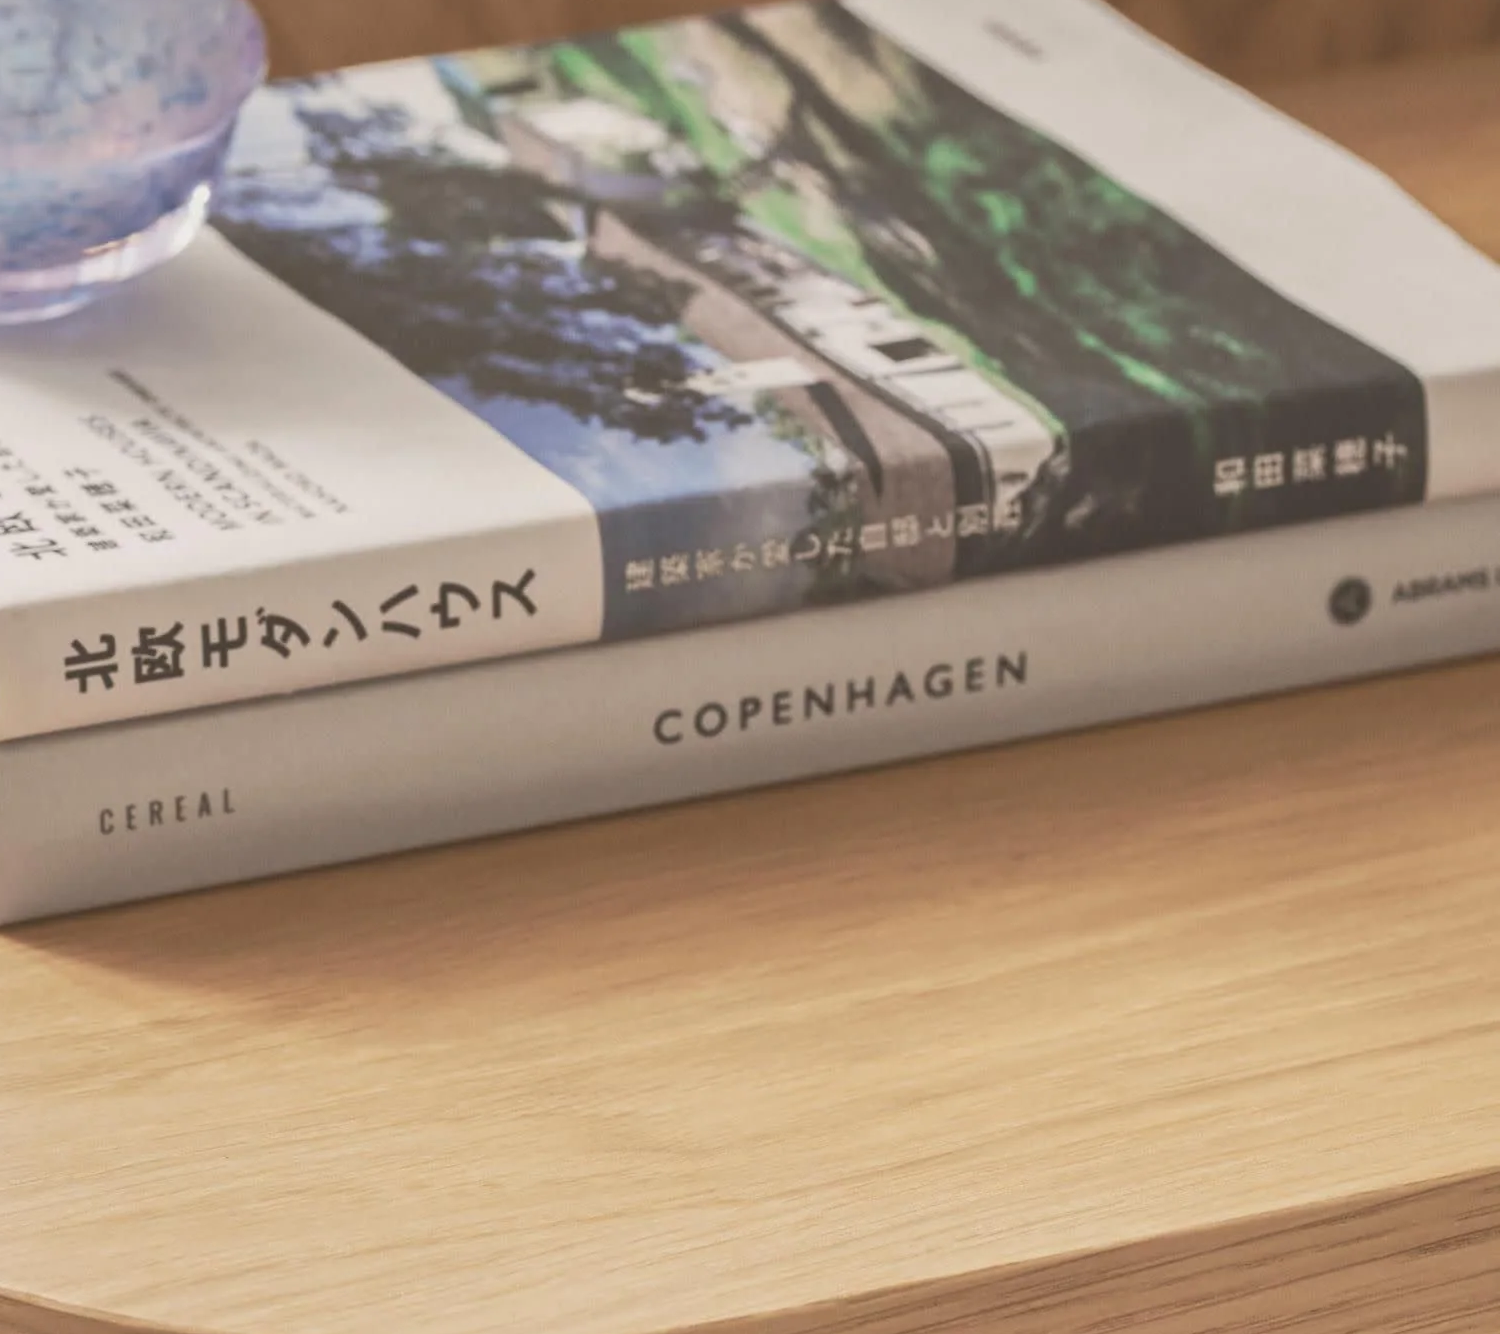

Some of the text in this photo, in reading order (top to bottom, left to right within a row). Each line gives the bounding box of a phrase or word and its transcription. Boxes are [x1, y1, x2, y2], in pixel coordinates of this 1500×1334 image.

[63, 568, 537, 694] 北欧モダンハウス
[99, 788, 235, 836] CEREAL
[652, 651, 1028, 745] COPENHAGEN
